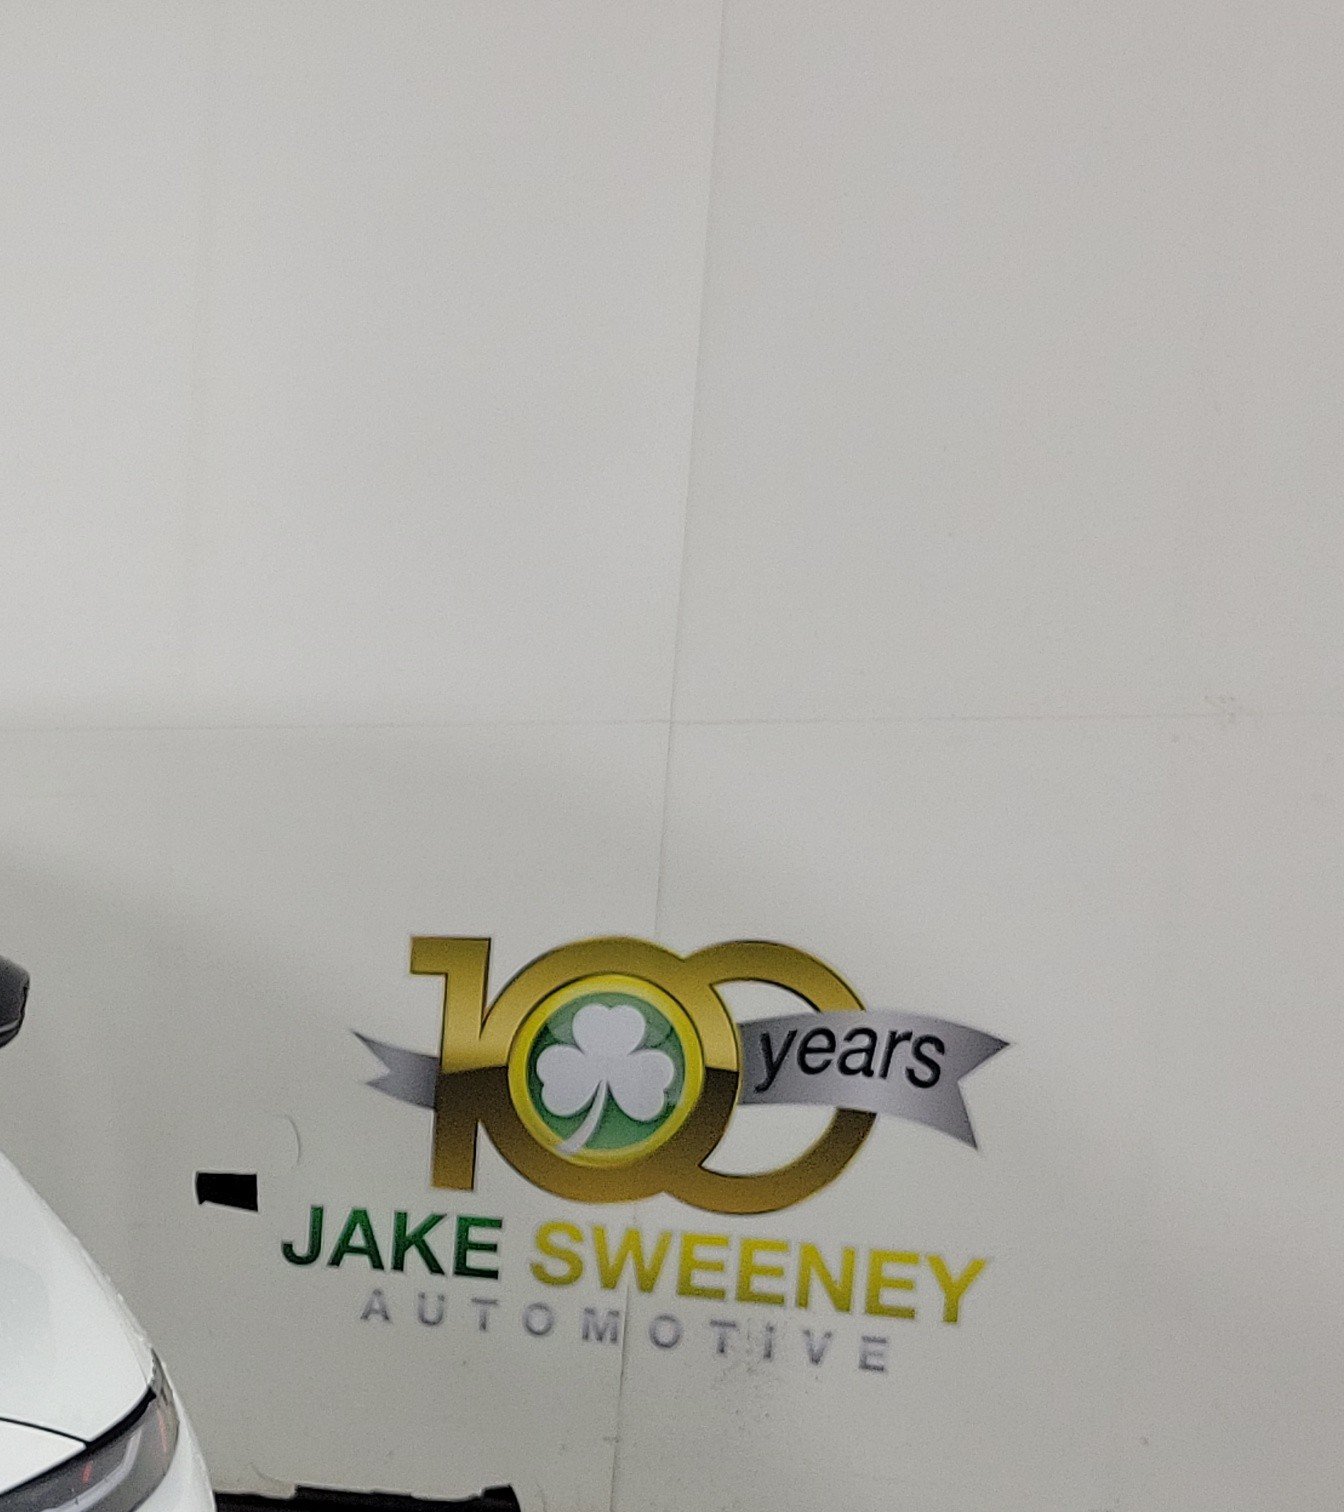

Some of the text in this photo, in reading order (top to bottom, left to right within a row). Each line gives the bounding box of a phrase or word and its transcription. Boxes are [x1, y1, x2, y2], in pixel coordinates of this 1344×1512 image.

[410, 936, 946, 1214] 100 years
[281, 1206, 990, 1325] JAKE SWEENEY
[361, 1288, 892, 1374] AUTOMOTIVE
